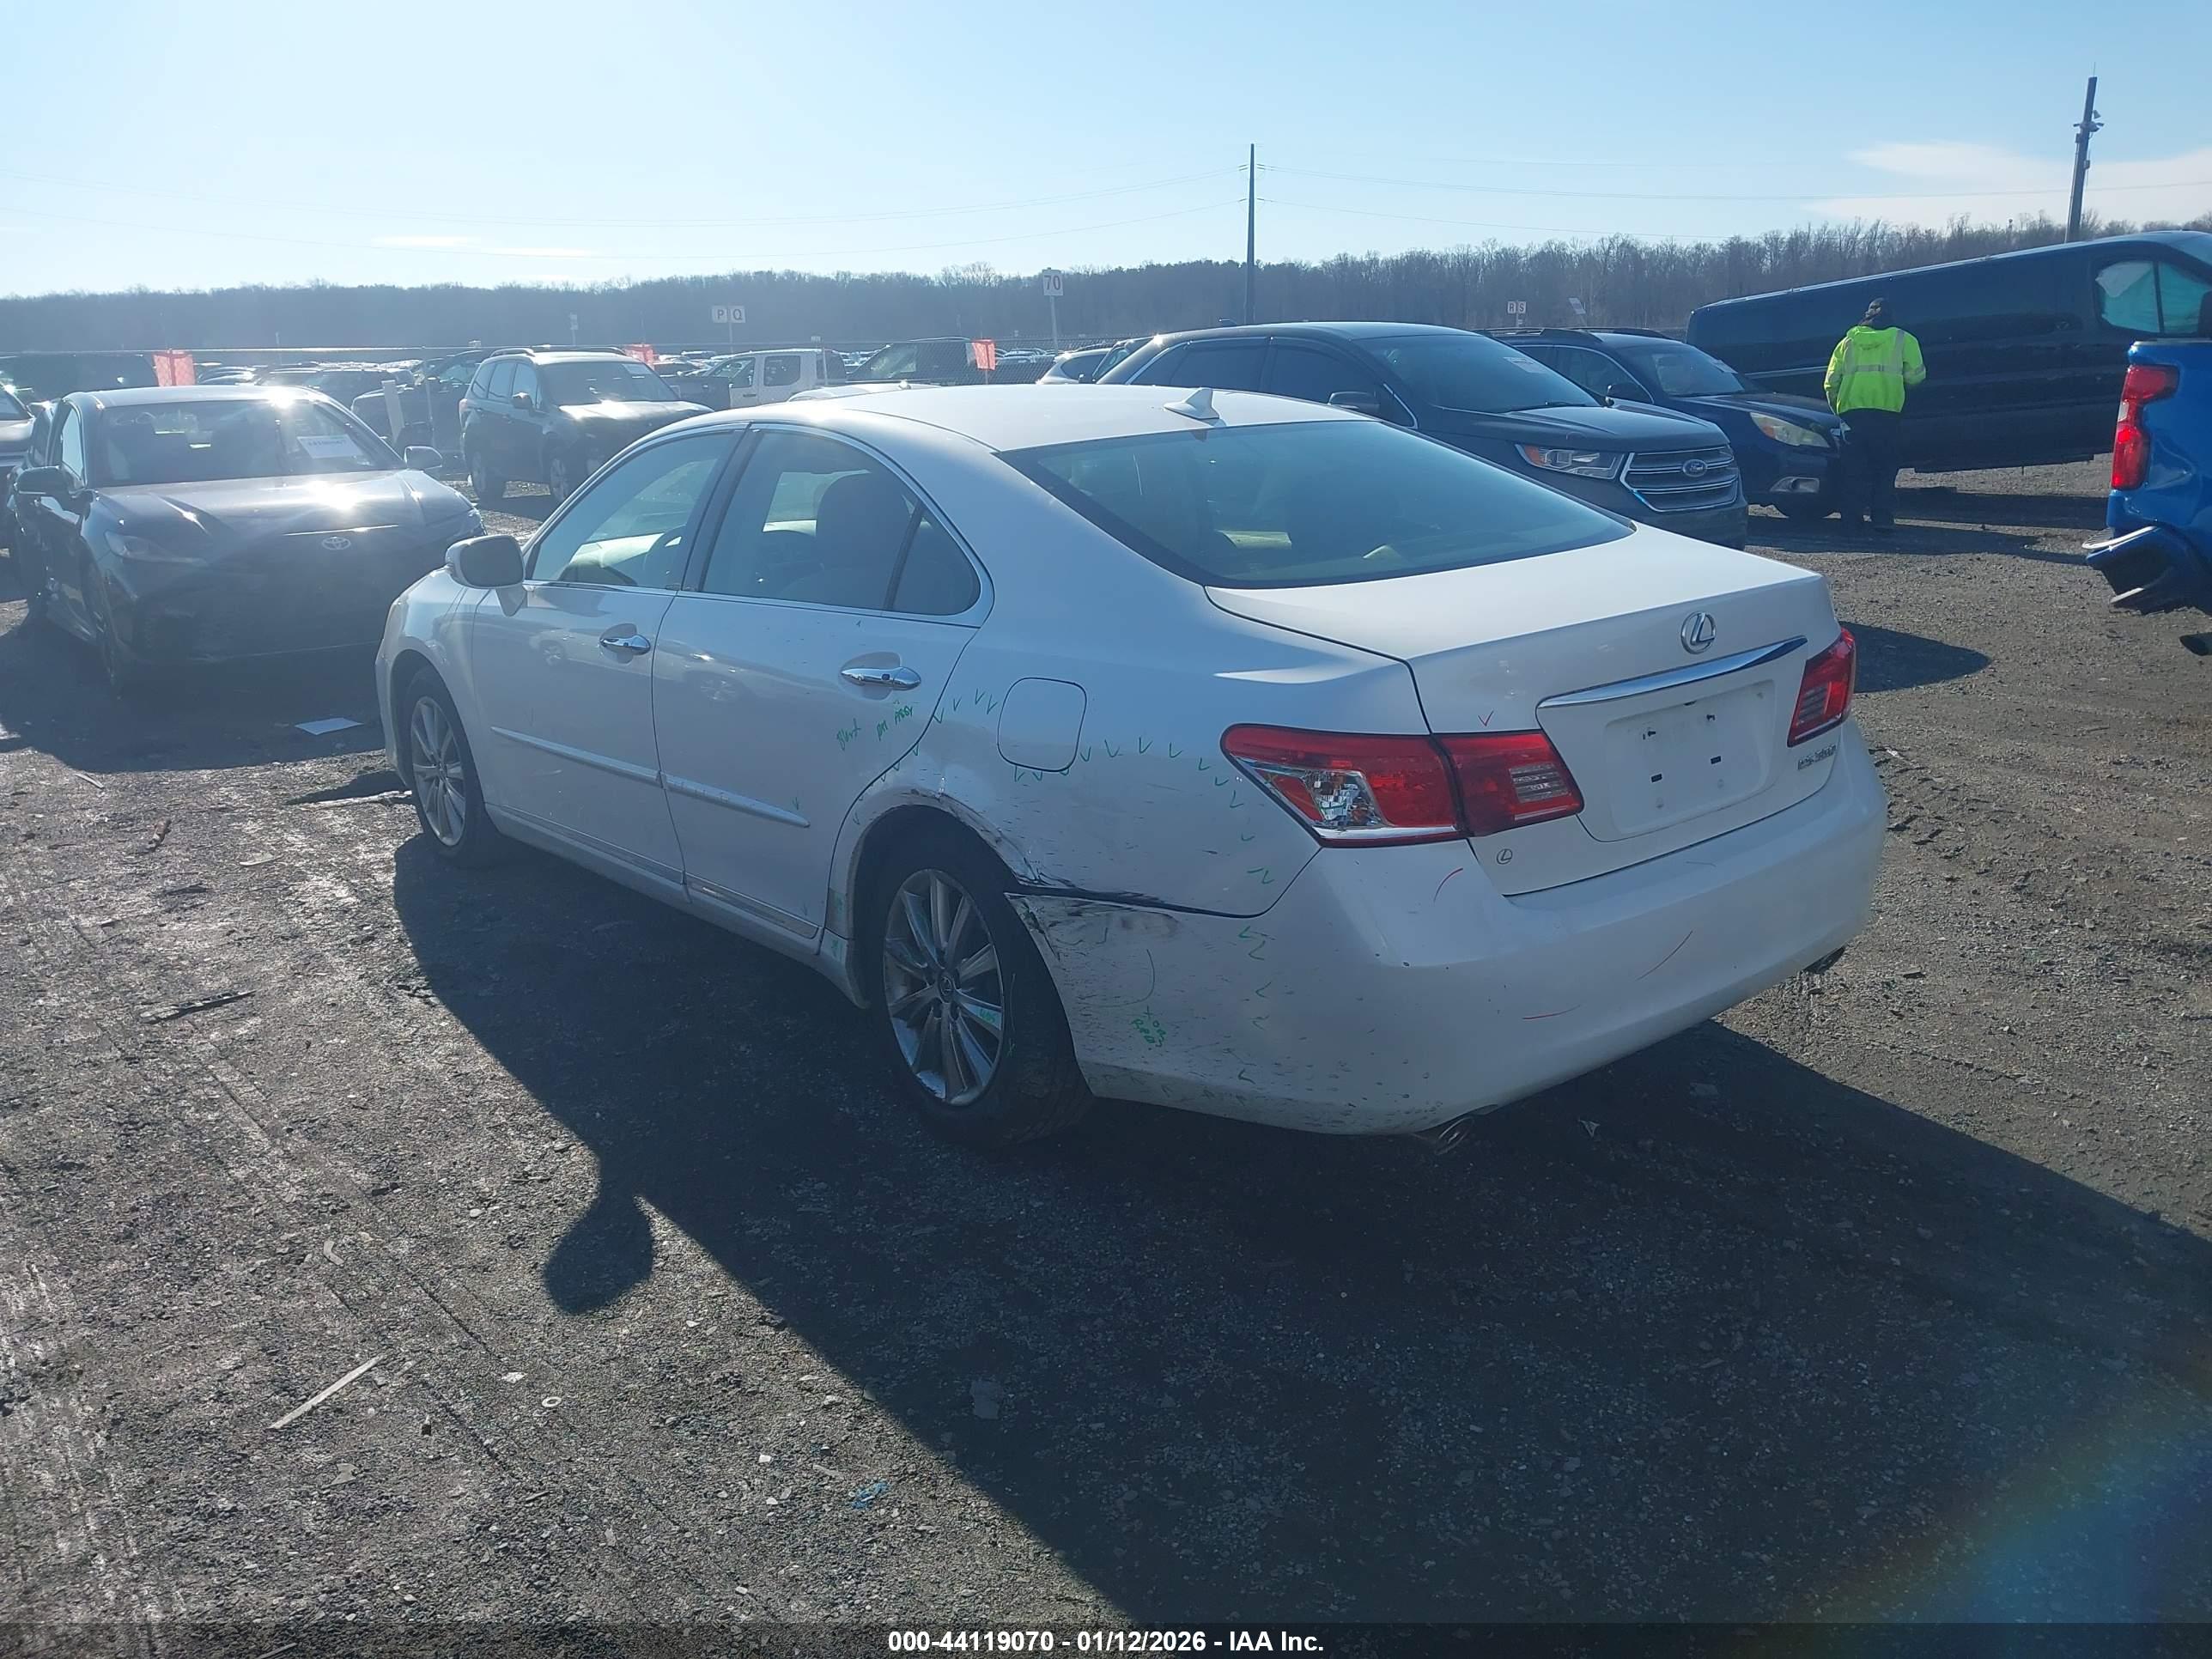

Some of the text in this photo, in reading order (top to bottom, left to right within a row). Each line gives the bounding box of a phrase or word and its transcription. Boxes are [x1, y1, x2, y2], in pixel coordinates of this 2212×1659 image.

[1043, 275, 1061, 290] 70
[1519, 302, 1525, 313] S
[717, 308, 743, 320] P Q
